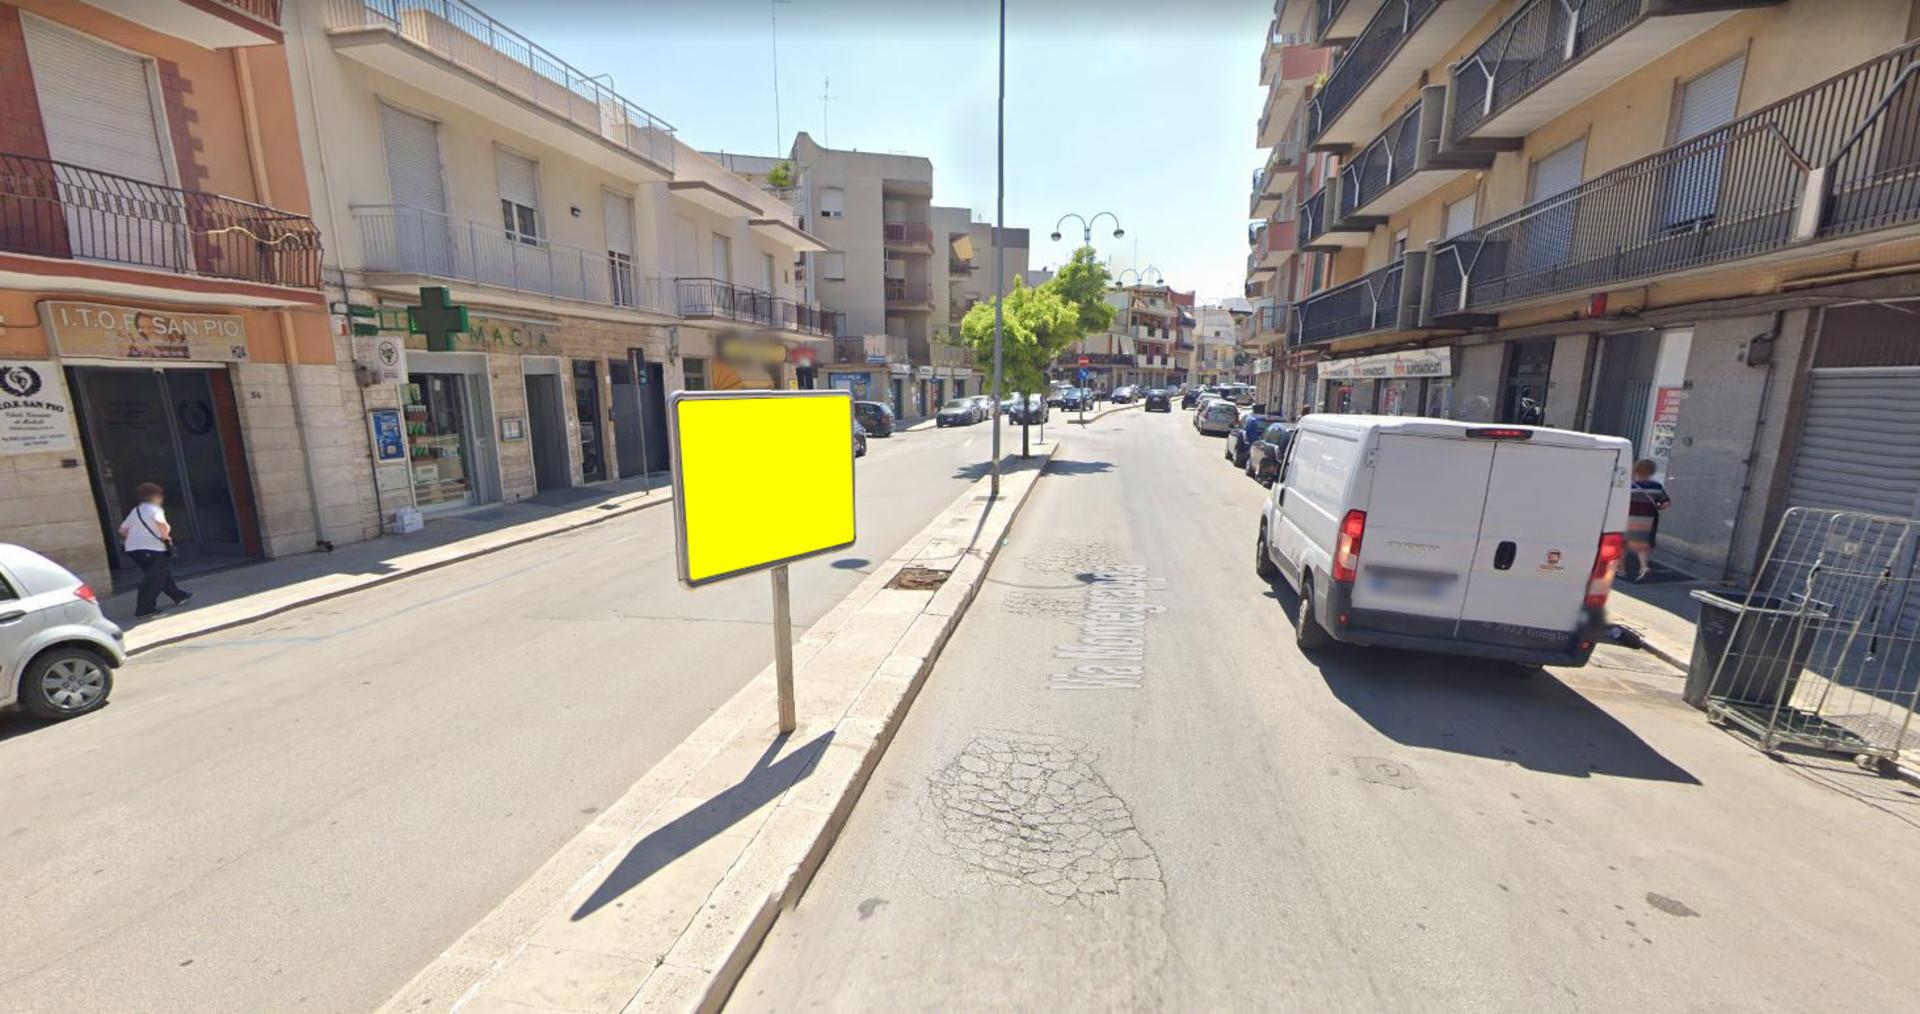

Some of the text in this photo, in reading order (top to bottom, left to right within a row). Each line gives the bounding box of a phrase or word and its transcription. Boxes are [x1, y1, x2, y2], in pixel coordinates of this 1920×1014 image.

[151, 316, 198, 335] SAN
[203, 319, 239, 337] PIO
[22, 400, 44, 409] SAN
[46, 402, 65, 413] PIO
